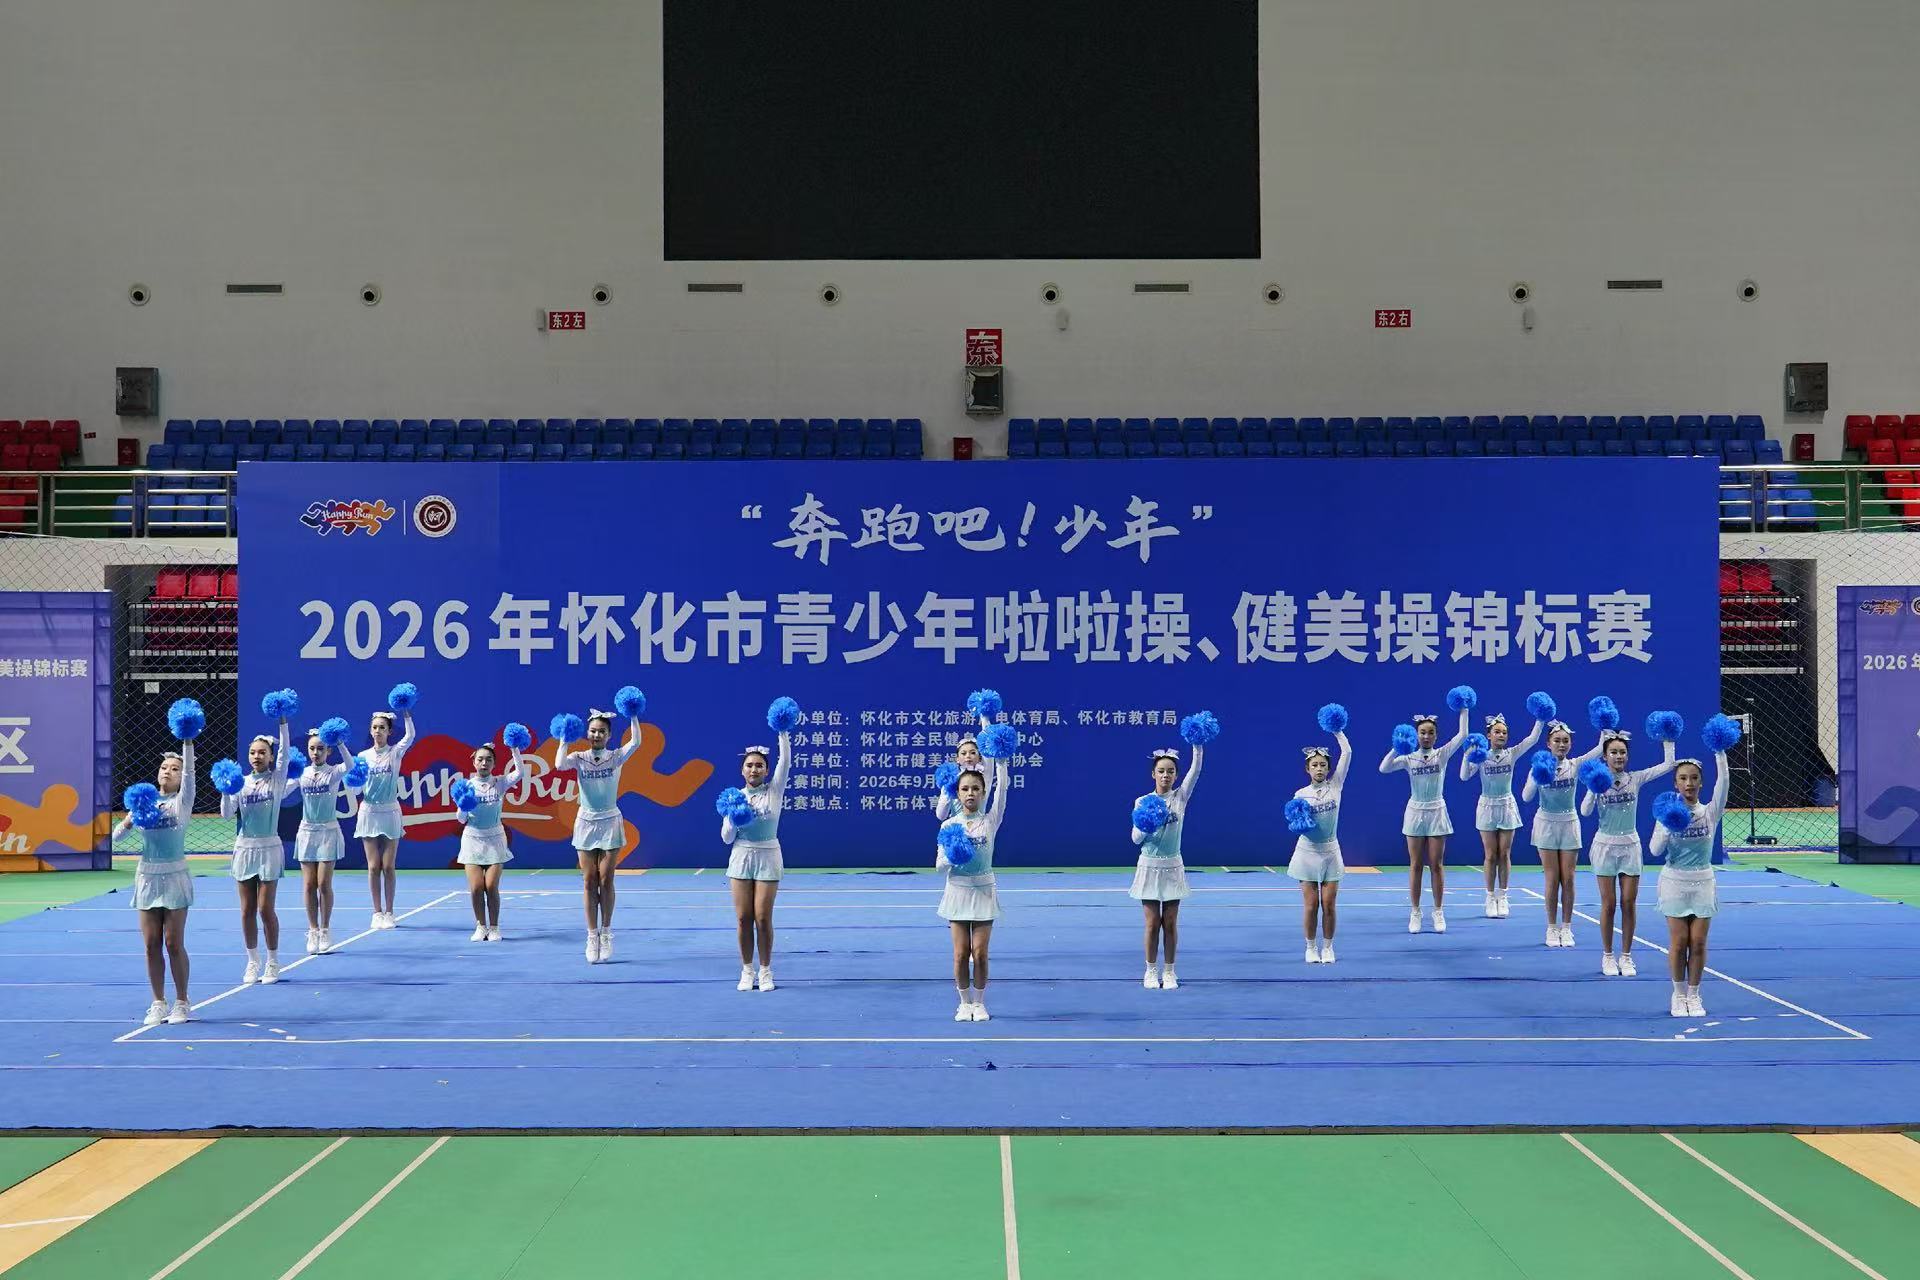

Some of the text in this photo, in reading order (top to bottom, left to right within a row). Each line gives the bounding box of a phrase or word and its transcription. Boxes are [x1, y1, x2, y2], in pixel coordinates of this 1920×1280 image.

[553, 313, 582, 328] 东2左
[1378, 311, 1408, 326] 东2右
[321, 507, 374, 521] Happy Run
[581, 767, 613, 778] CHEER
[1411, 764, 1440, 776] CHEER
[502, 754, 580, 806] Ru
